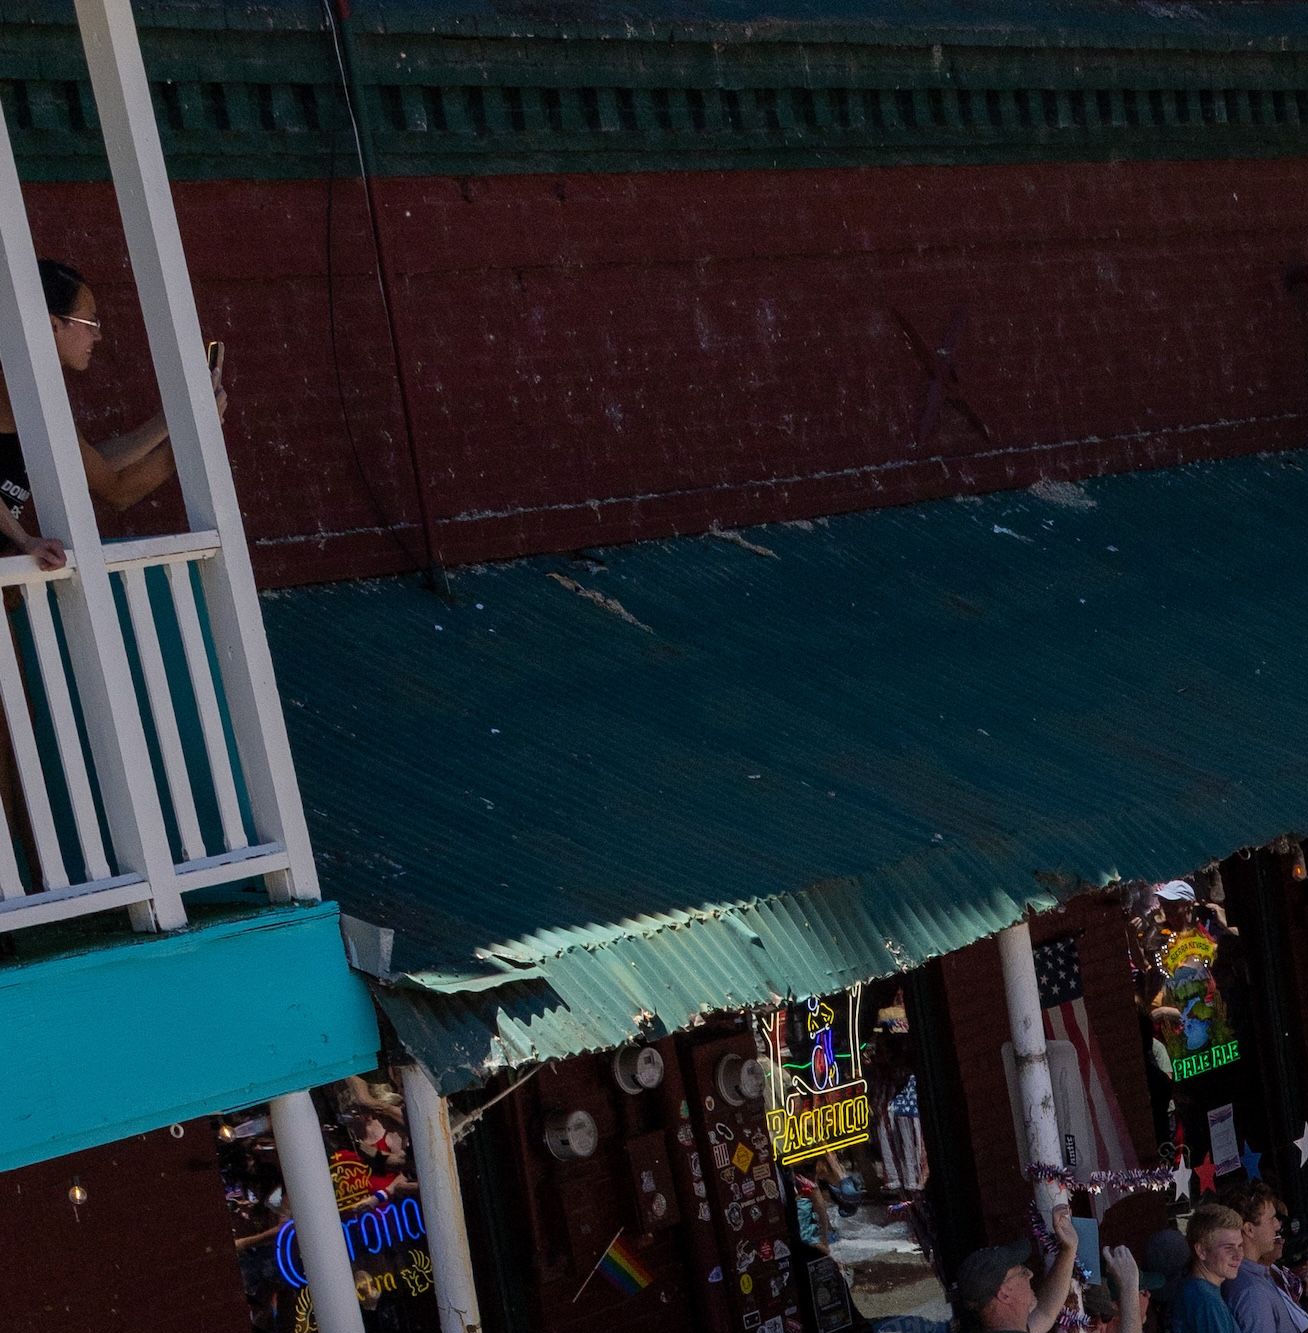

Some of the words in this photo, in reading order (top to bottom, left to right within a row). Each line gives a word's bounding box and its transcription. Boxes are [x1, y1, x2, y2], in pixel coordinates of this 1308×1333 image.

[1172, 1051, 1211, 1082] PALE
[1211, 1040, 1241, 1073] ALE
[765, 1094, 869, 1162] PACIFICO
[275, 1196, 426, 1288] Crona
